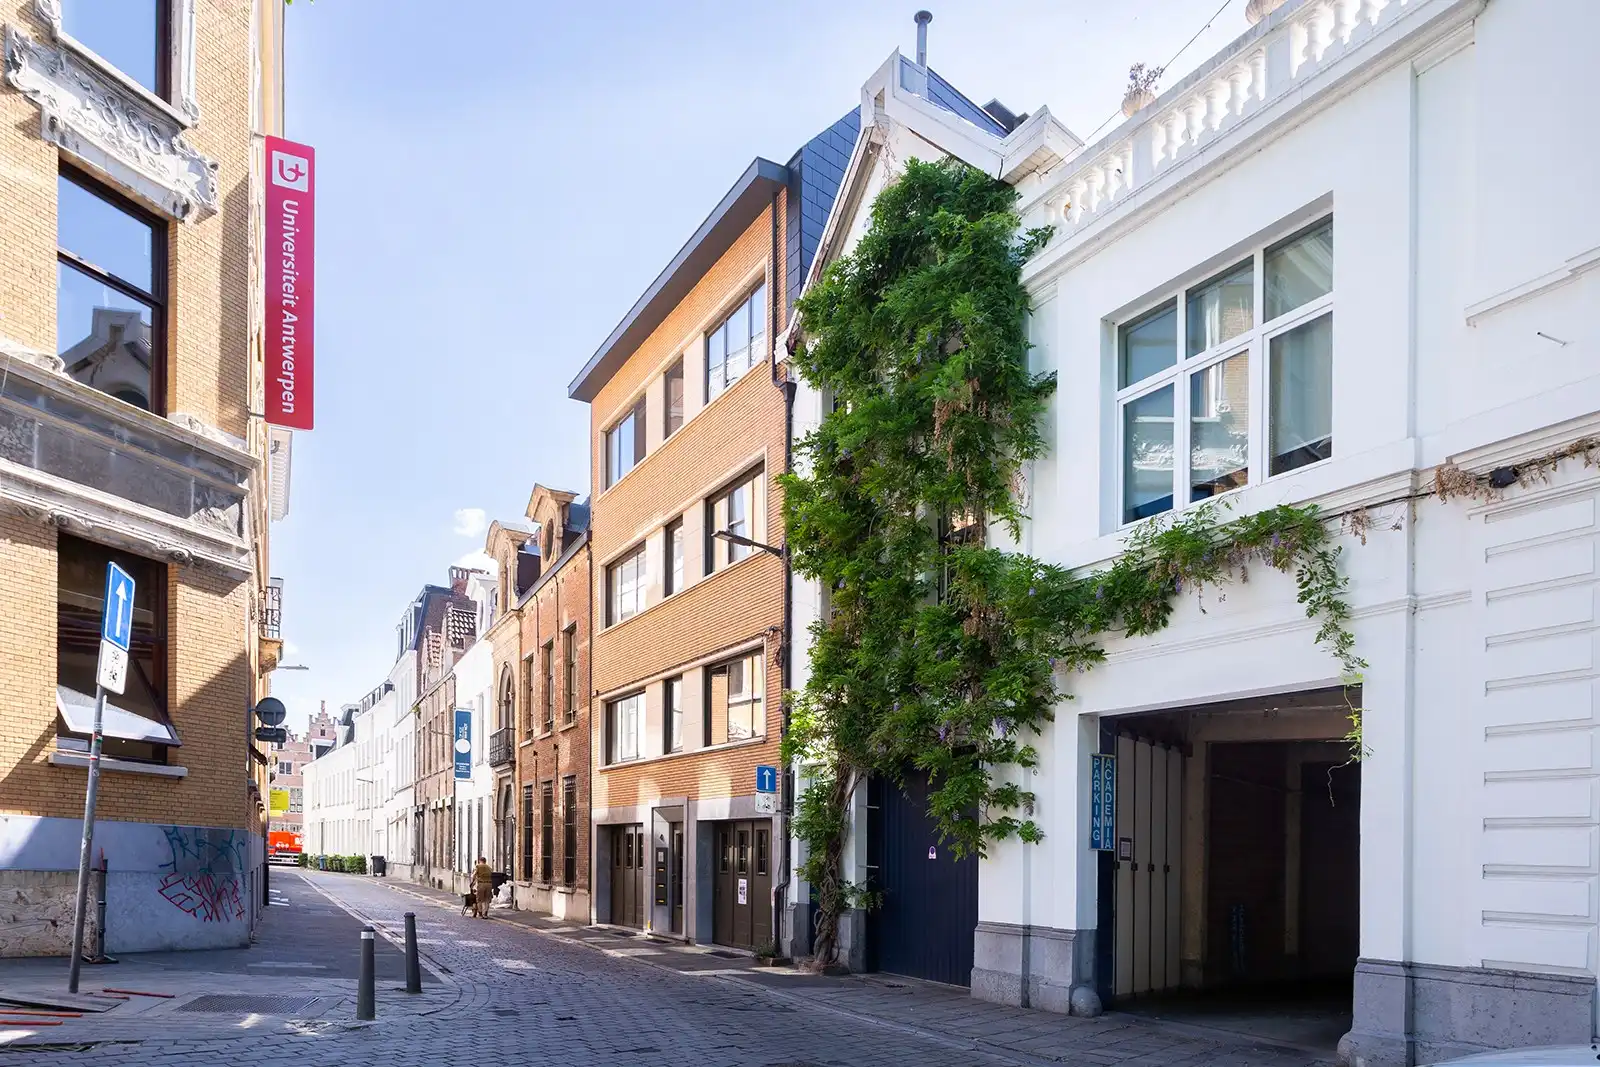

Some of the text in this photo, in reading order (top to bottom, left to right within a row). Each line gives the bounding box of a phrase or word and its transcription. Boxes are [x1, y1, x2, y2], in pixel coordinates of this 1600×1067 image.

[277, 199, 300, 414] Universiteit Antwerpen
[1092, 758, 1101, 841] PARKING
[1104, 759, 1113, 849] ACADEMIA
